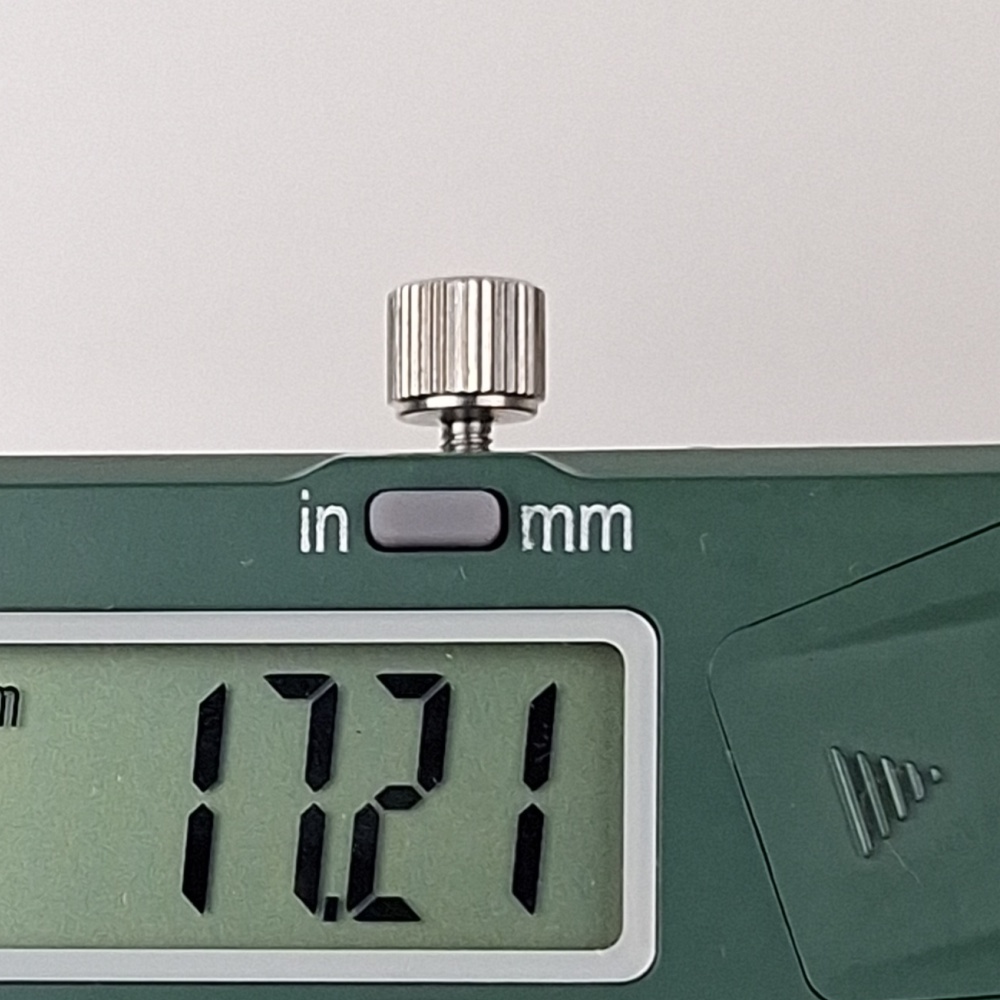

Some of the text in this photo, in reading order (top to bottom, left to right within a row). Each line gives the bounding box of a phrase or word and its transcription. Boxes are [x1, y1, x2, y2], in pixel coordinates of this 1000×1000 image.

[299, 489, 349, 552] in
[521, 504, 633, 552] mm
[181, 673, 557, 922] 17.21
